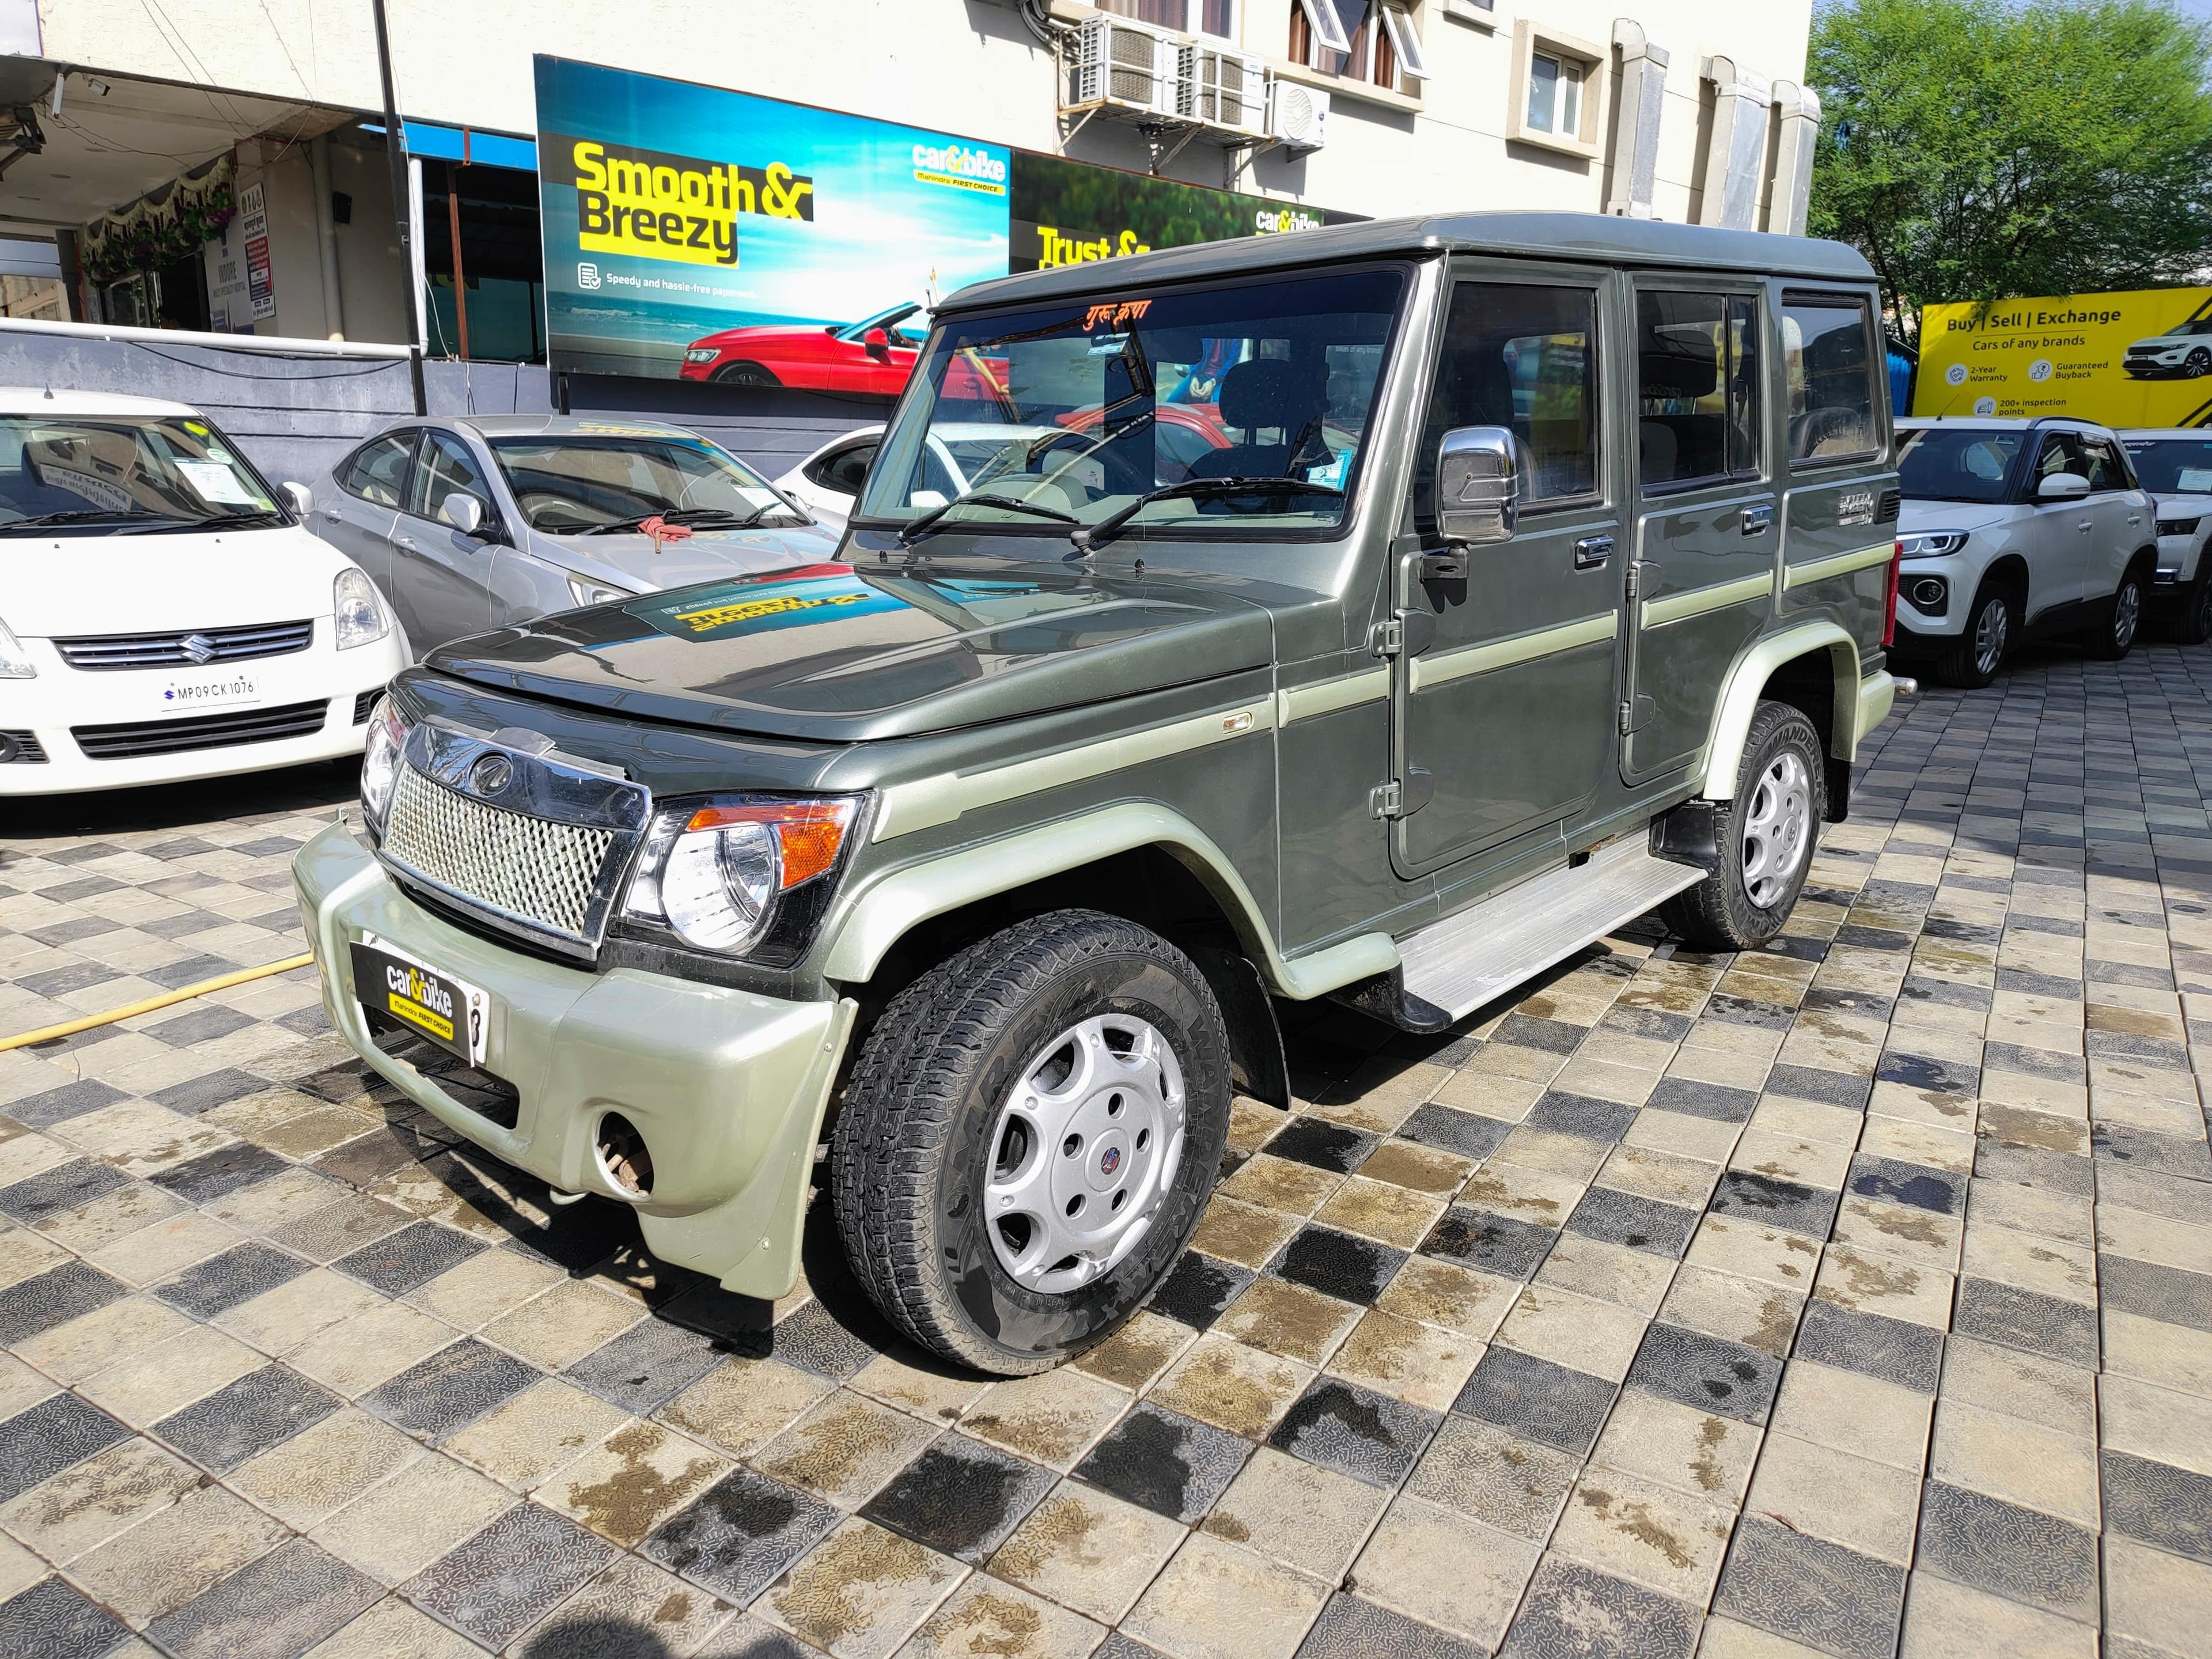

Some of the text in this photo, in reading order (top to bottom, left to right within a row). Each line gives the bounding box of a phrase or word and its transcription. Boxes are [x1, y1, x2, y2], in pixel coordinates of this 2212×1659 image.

[574, 142, 813, 220] Smooth &
[953, 179, 972, 188] FIRST
[974, 183, 998, 192] CHOICE
[579, 188, 739, 264] Breezy
[1037, 226, 1111, 268] Trust
[607, 272, 641, 288] Speedy
[643, 278, 660, 289] and
[662, 279, 711, 295] hassle-free
[1947, 319, 1977, 332] Buy
[1991, 313, 2021, 328] Sell
[2037, 309, 2121, 325] Exchange
[1973, 335, 2085, 350] Cars of any brands
[2056, 361, 2108, 370] Guaranteed
[1970, 374, 2008, 382] Warranty
[2055, 371, 2092, 380] Buyback
[1999, 399, 2066, 408] 200+ inspection
[1999, 408, 2025, 416] points
[177, 681, 254, 700] MP09CK1076
[387, 965, 453, 1018] car&bike
[418, 1012, 433, 1025] FIRST
[433, 1019, 451, 1035] CHOICE
